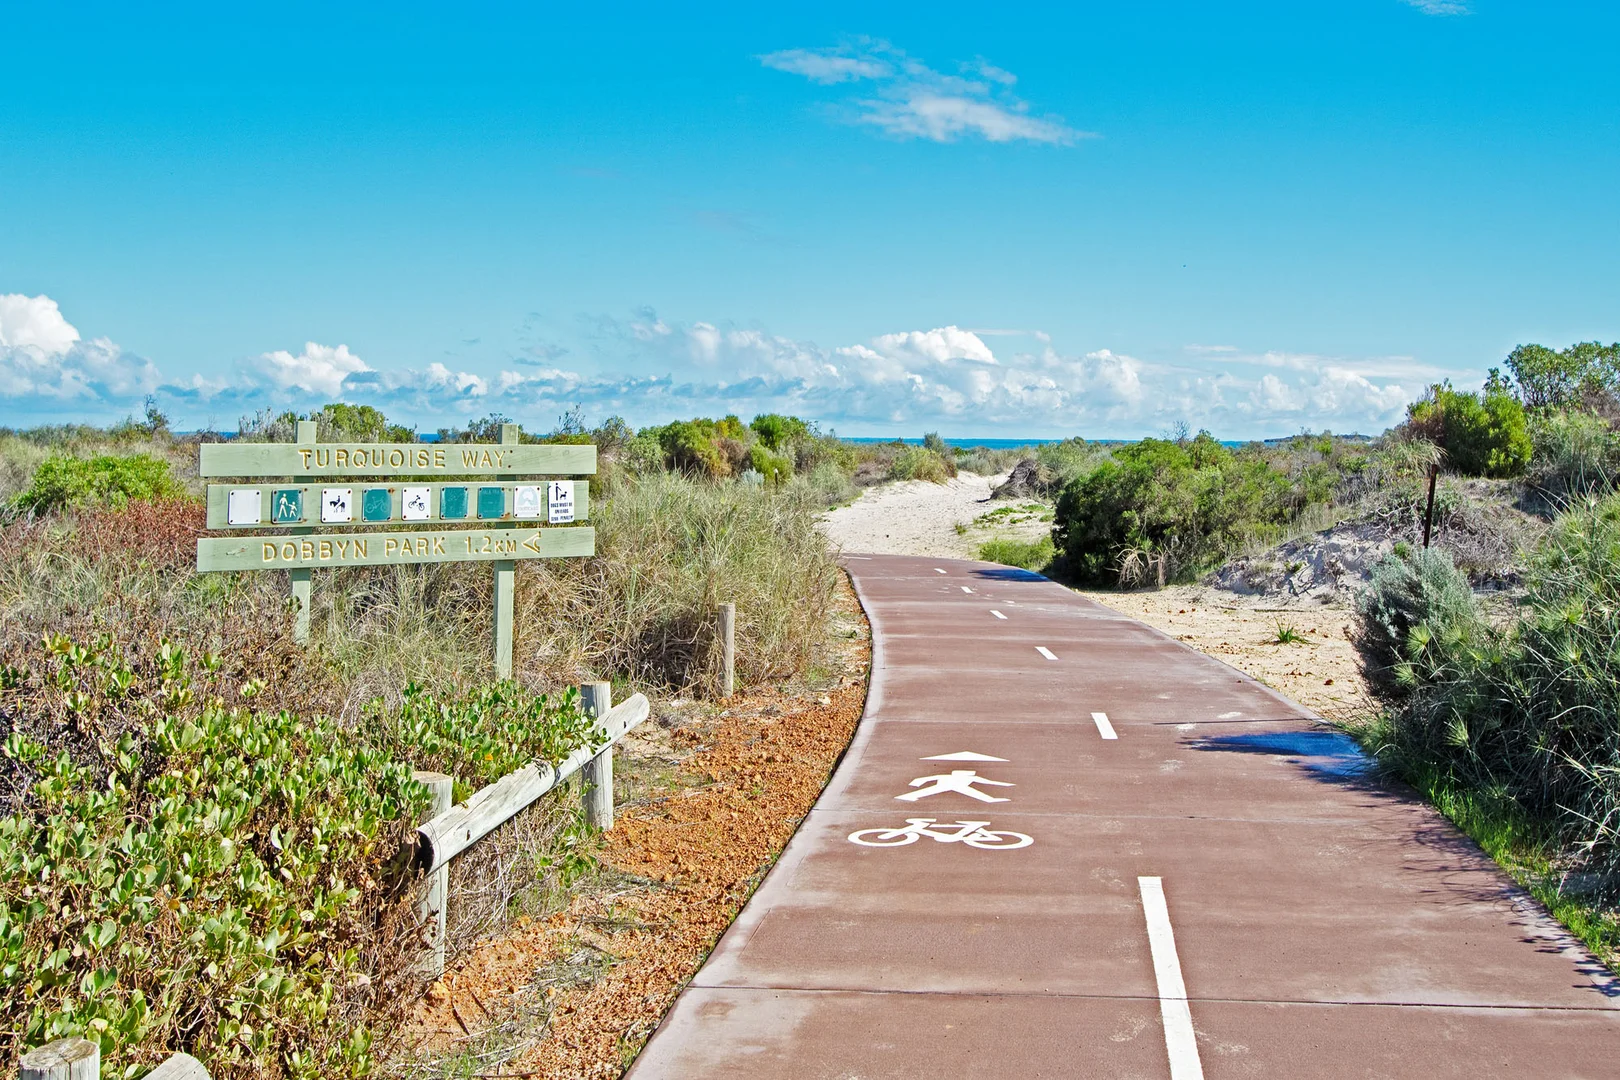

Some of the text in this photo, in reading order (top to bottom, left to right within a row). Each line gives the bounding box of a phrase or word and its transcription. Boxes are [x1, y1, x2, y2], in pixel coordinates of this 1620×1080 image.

[298, 448, 506, 470] TURQUOISE WAY
[261, 540, 368, 562] DOBBYN
[384, 536, 446, 558] PARK
